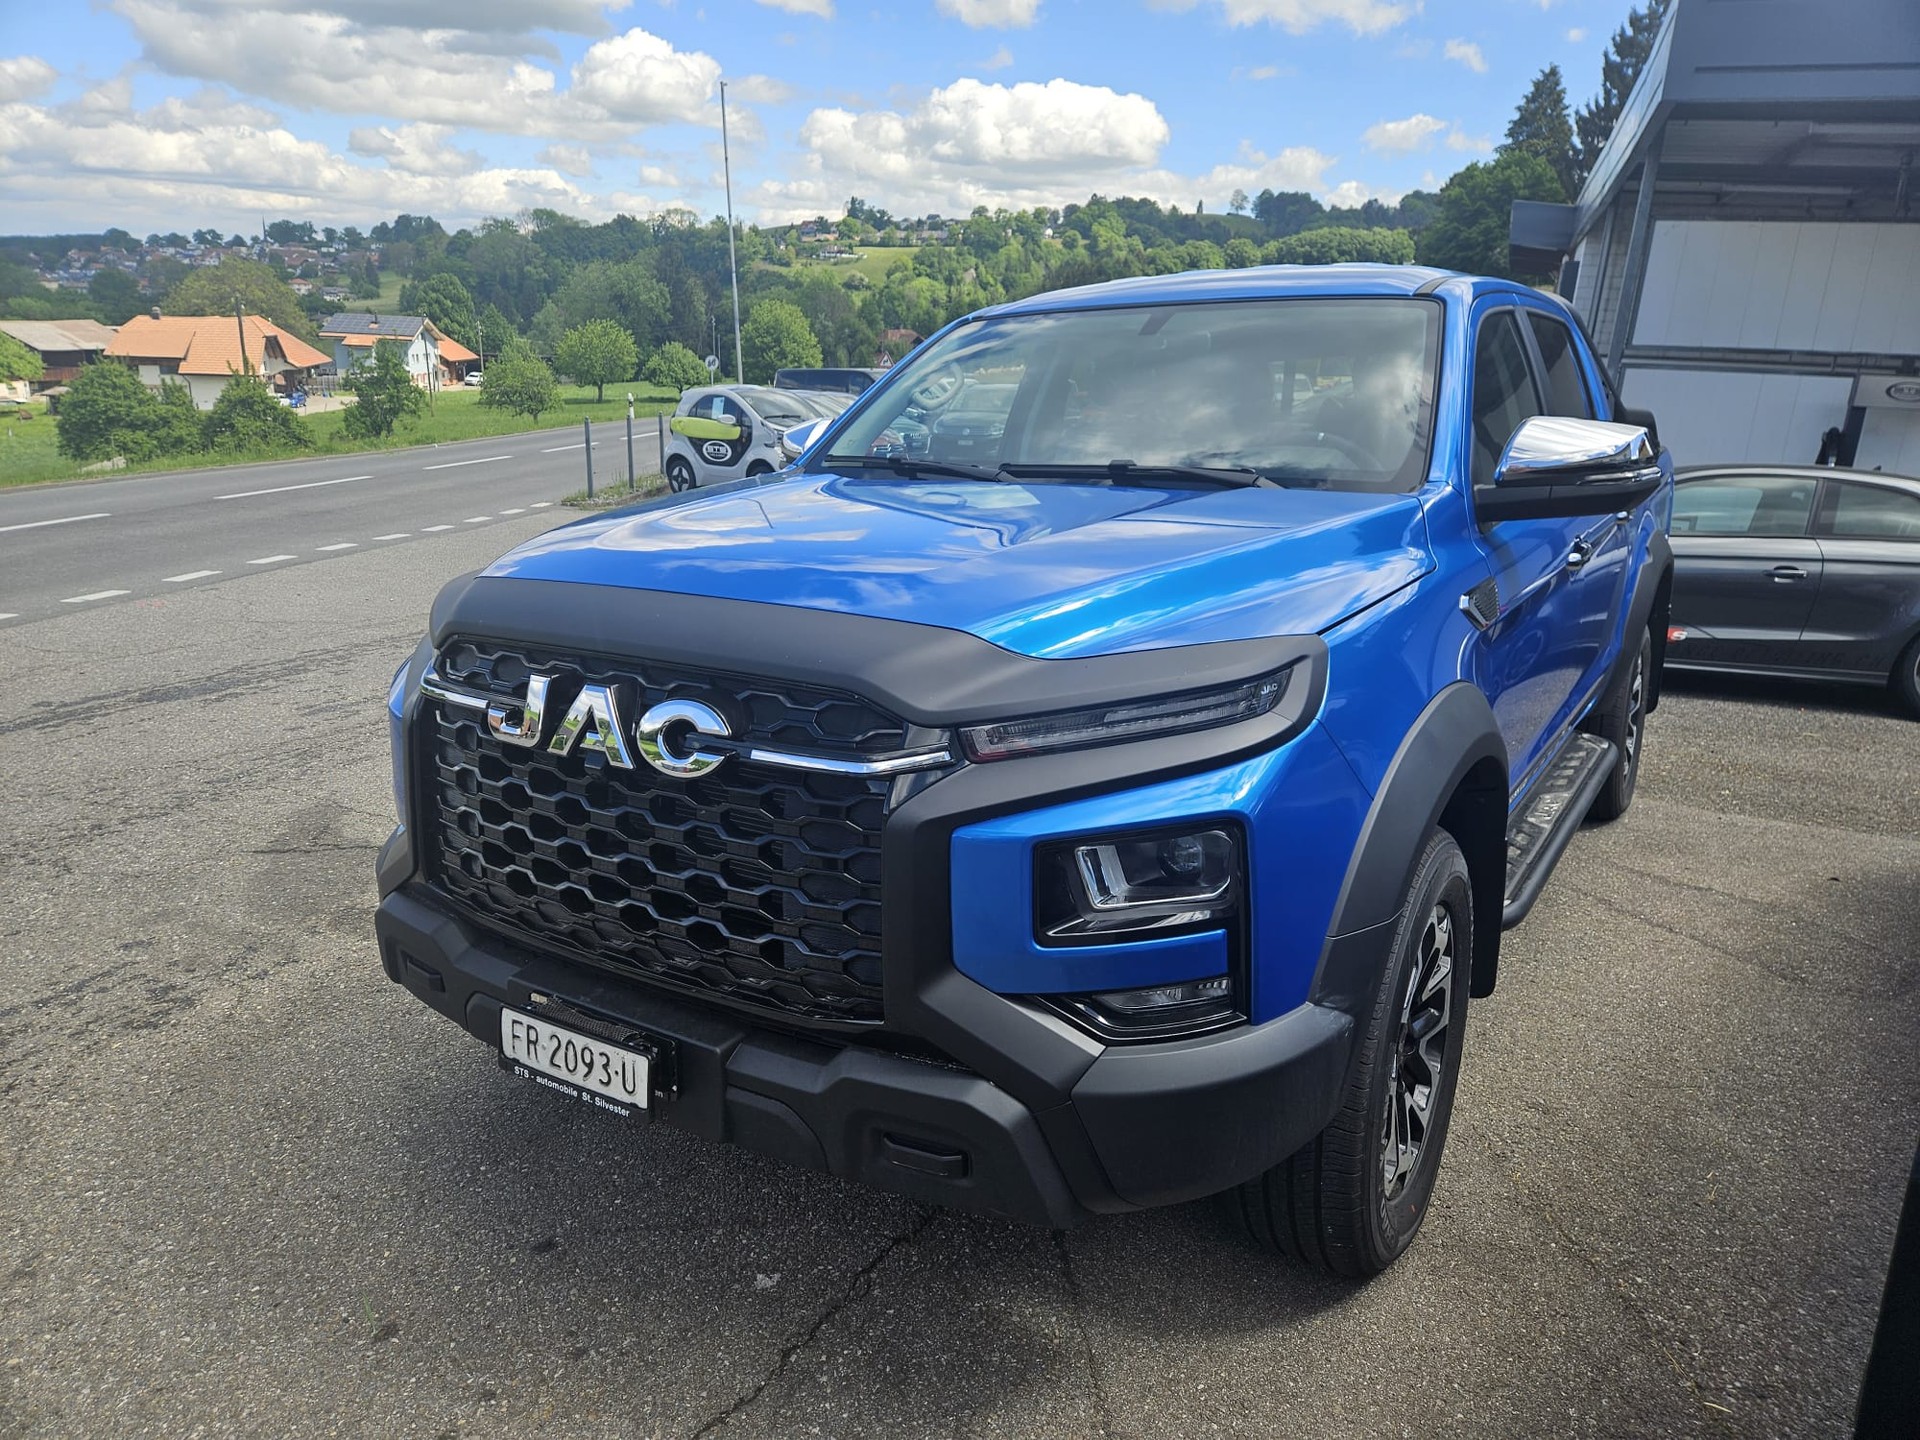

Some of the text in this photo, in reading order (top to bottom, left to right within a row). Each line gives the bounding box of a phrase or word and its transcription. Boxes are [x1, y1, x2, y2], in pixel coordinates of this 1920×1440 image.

[1261, 683, 1278, 695] JAC
[487, 673, 734, 778] JAC
[514, 1066, 530, 1079] STS
[536, 1074, 578, 1098] automobile
[582, 1093, 593, 1104] St.
[594, 1096, 630, 1117] Silvester
